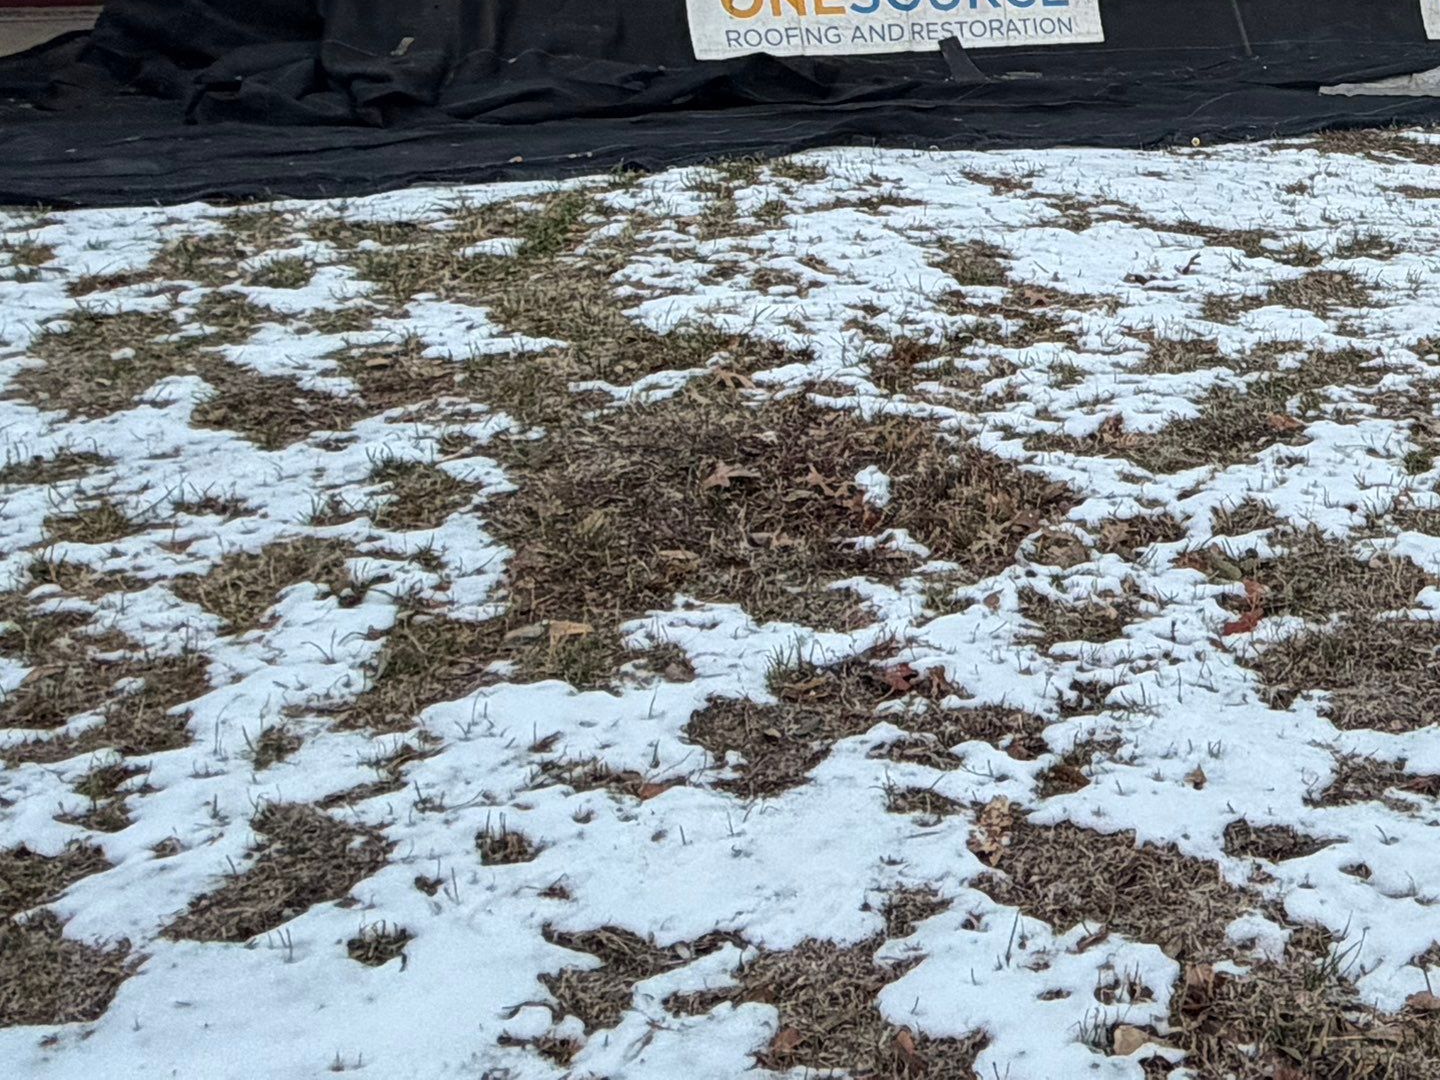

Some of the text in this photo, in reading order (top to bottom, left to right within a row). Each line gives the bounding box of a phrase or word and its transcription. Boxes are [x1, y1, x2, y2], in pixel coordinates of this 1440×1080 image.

[725, 16, 1073, 48] ROOFING AND RESTORATION
